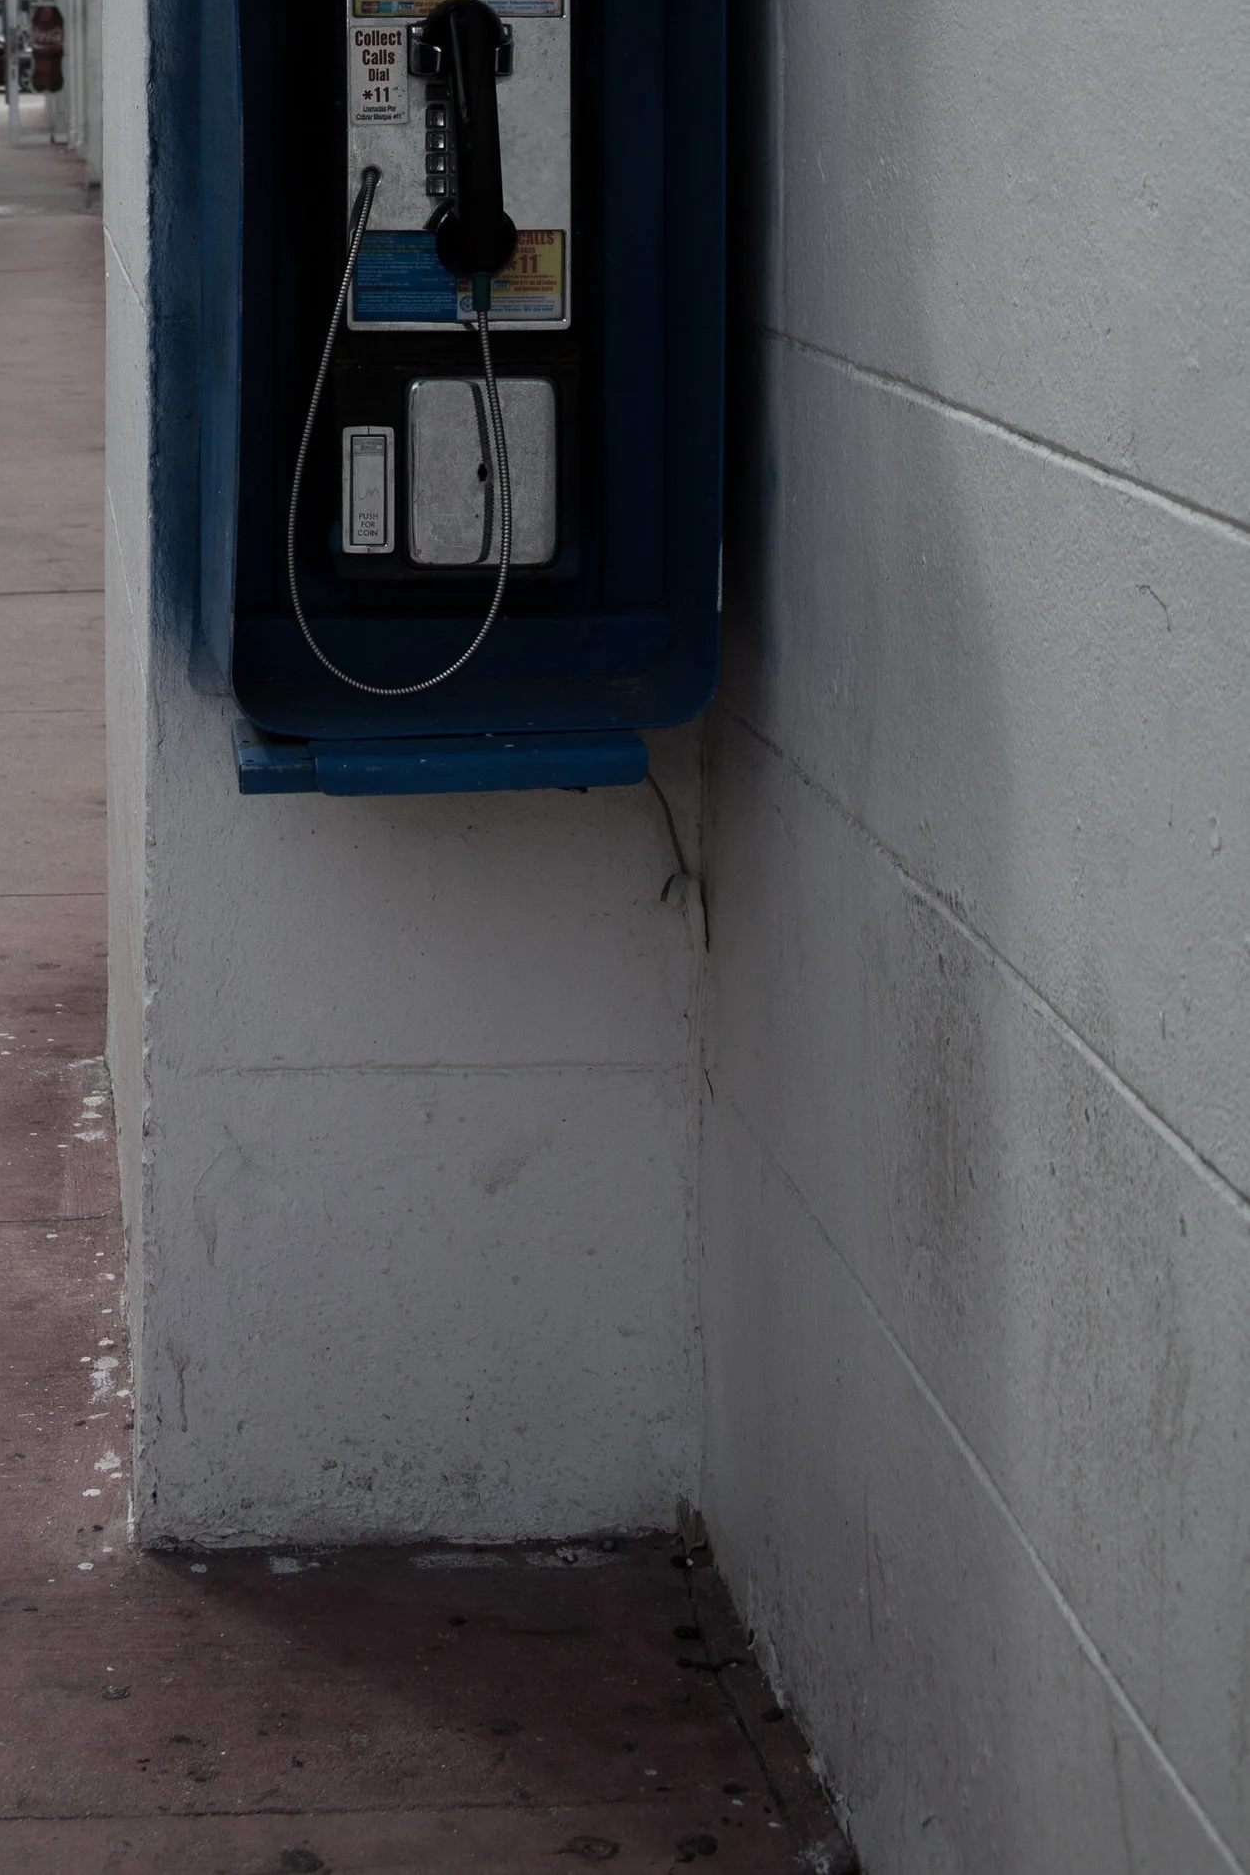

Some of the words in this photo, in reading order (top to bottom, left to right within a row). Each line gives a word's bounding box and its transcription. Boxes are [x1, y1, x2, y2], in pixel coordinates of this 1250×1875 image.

[355, 30, 402, 47] Collect
[362, 49, 395, 65] Calls
[368, 68, 390, 82] Dial
[358, 512, 379, 521] PUSH
[360, 521, 376, 529] FOR
[357, 529, 379, 537] COIN
